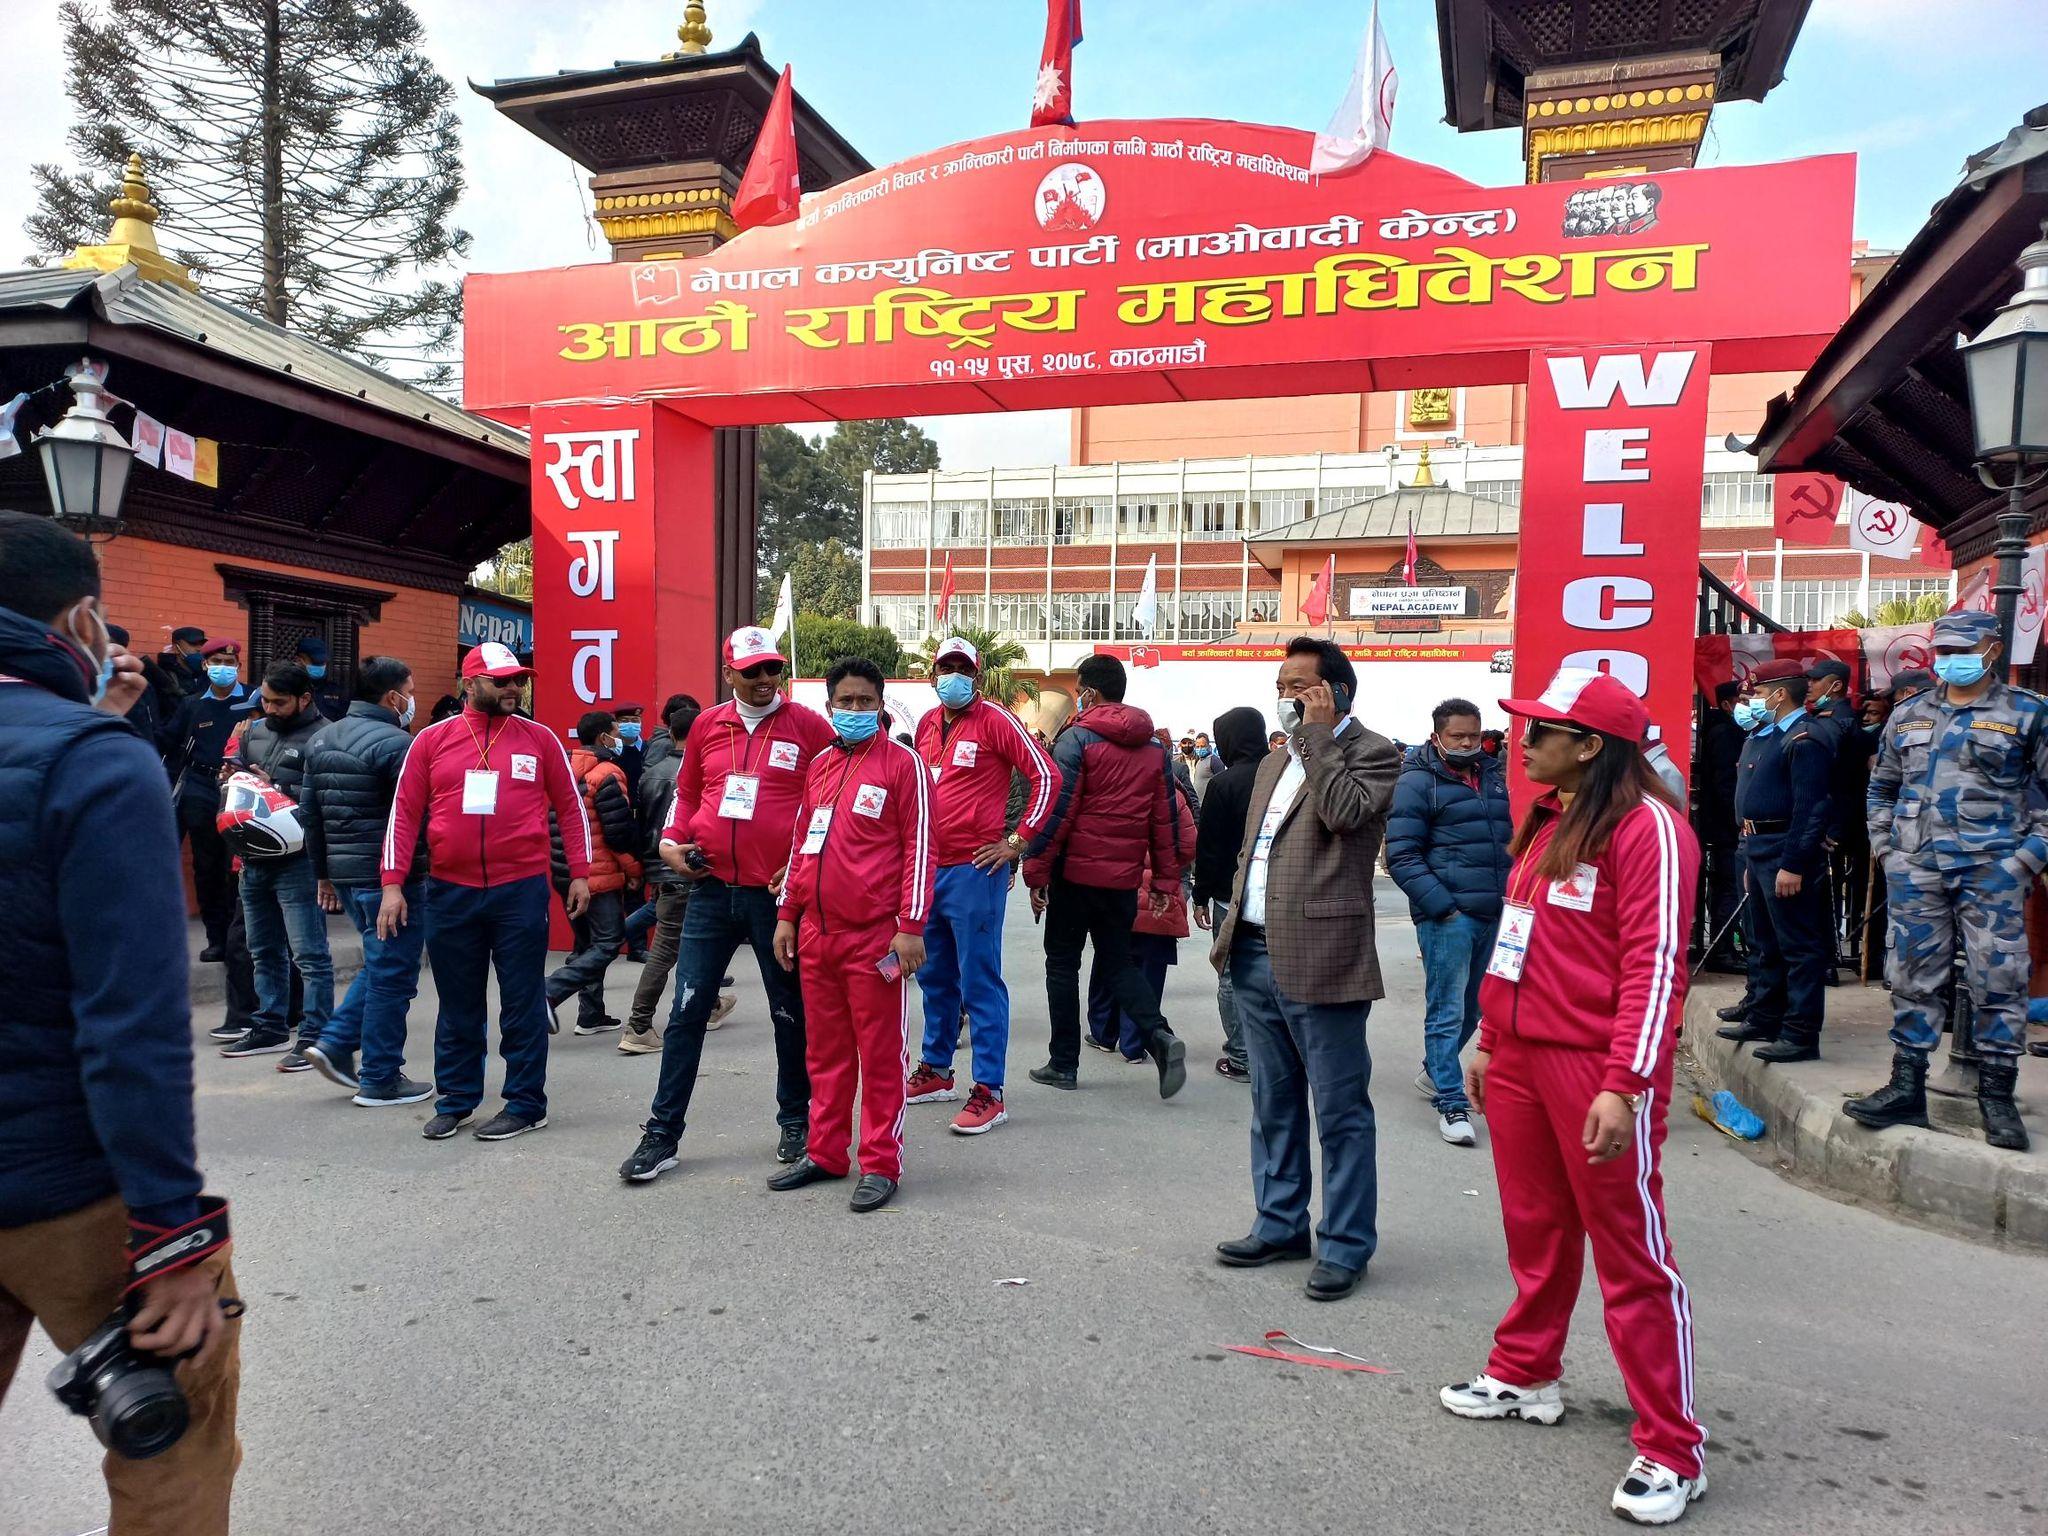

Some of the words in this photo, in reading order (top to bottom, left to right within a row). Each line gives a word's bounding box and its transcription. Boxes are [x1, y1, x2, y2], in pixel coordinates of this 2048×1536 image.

[823, 178, 889, 219] क्रान्तिकारी
[893, 168, 927, 192] विचार
[930, 164, 939, 179] र
[943, 145, 1013, 177] क्रान्तिकारी
[1018, 141, 1046, 161] पार्टी
[1048, 137, 1109, 158] निर्माणका
[1113, 135, 1147, 156] लागि
[1187, 143, 1232, 168] राष्ट्रिय
[1236, 152, 1310, 184] महाधिवेशन
[690, 265, 800, 294] नेपाल
[815, 246, 1012, 285] कम्युनिष्ट
[1028, 233, 1121, 270] पार्टी
[1135, 215, 1366, 262] (माओवादी
[1379, 207, 1519, 244] केन्द्र)
[785, 287, 1087, 350] राष्ट्रिय
[1116, 245, 1711, 327] महाधिवेशन
[929, 356, 989, 377] ११-१५
[458, 604, 524, 646] Nepal
[1371, 603, 1405, 612] NEPAL
[1407, 603, 1459, 612] ACADEMY
